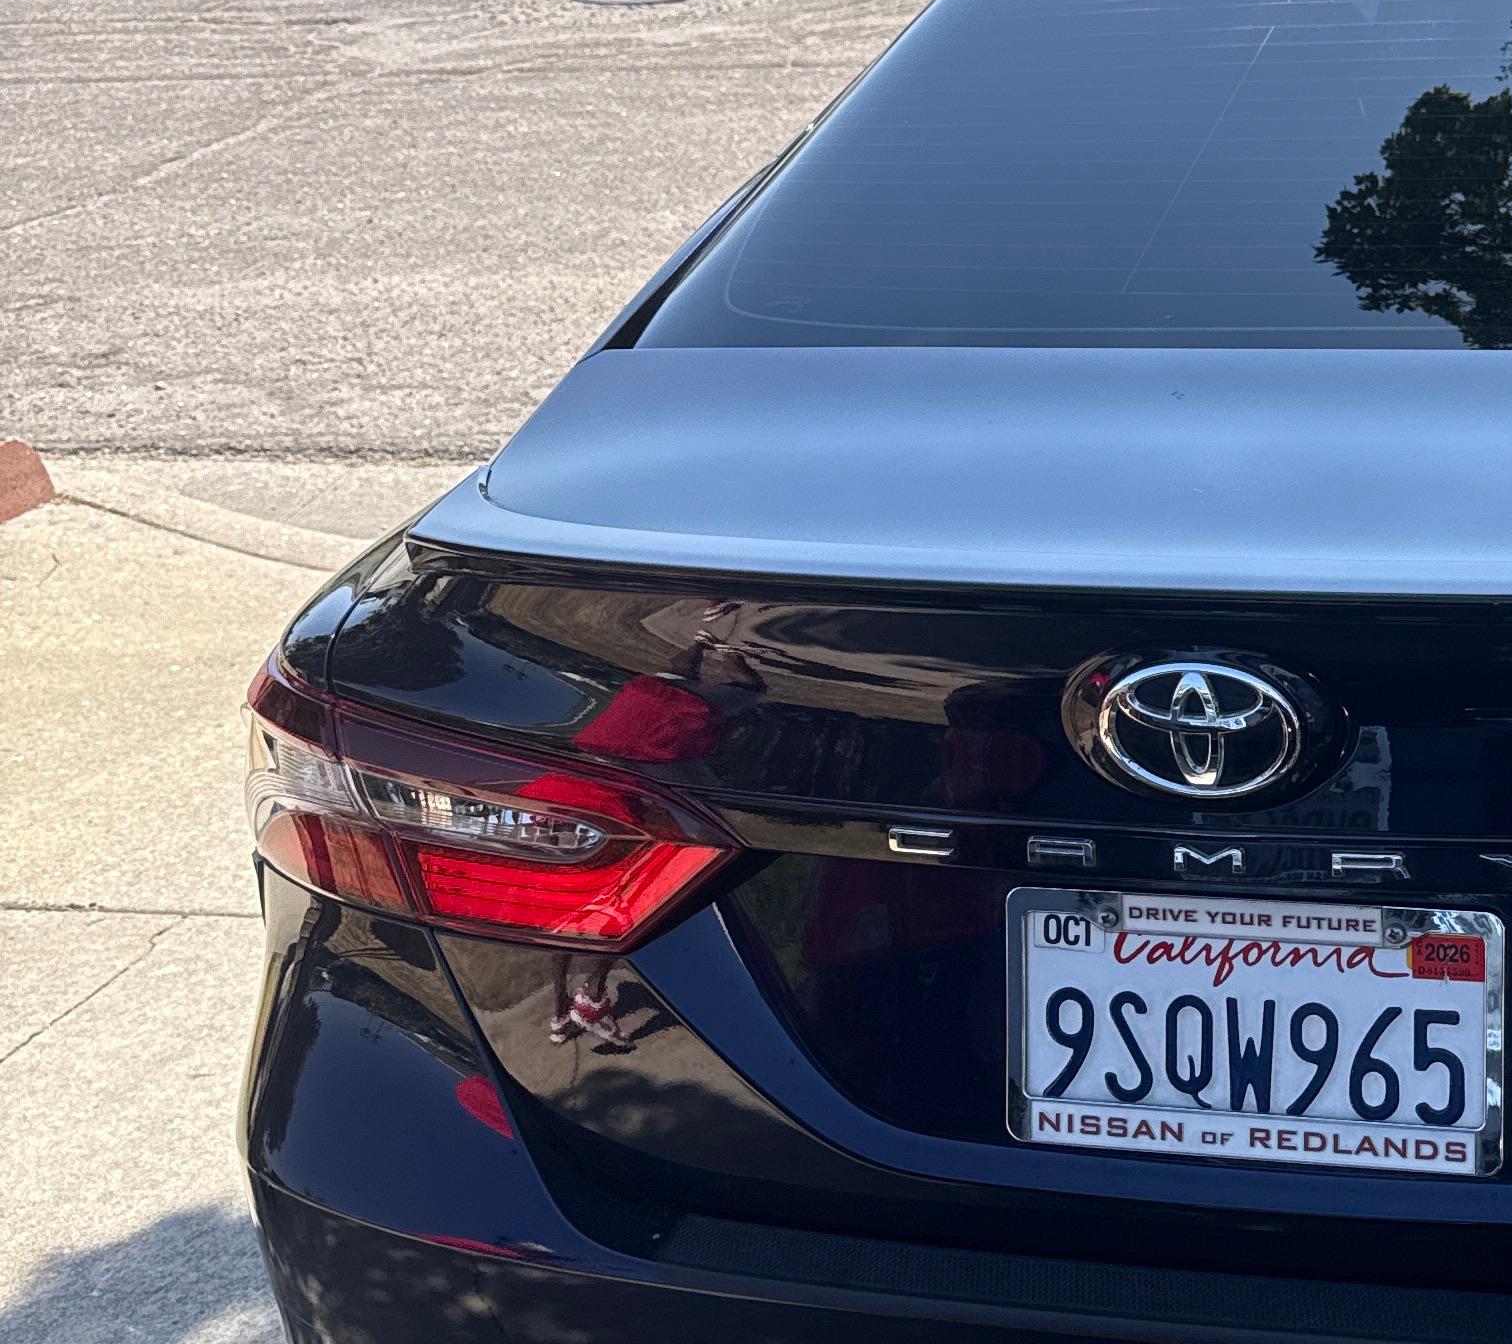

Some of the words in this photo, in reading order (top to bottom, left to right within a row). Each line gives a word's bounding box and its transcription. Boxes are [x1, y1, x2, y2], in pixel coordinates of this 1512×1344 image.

[1043, 914, 1092, 947] OCT
[1128, 906, 1199, 923] DRIVE
[1206, 911, 1273, 927] YOUR
[1282, 915, 1377, 933] FUTURE
[1113, 931, 1410, 988] California
[1424, 942, 1471, 964] 2026
[1042, 987, 1466, 1126] 9SQW965
[1038, 1112, 1185, 1143] NISSAN
[1249, 1127, 1469, 1164] REDLANDS
